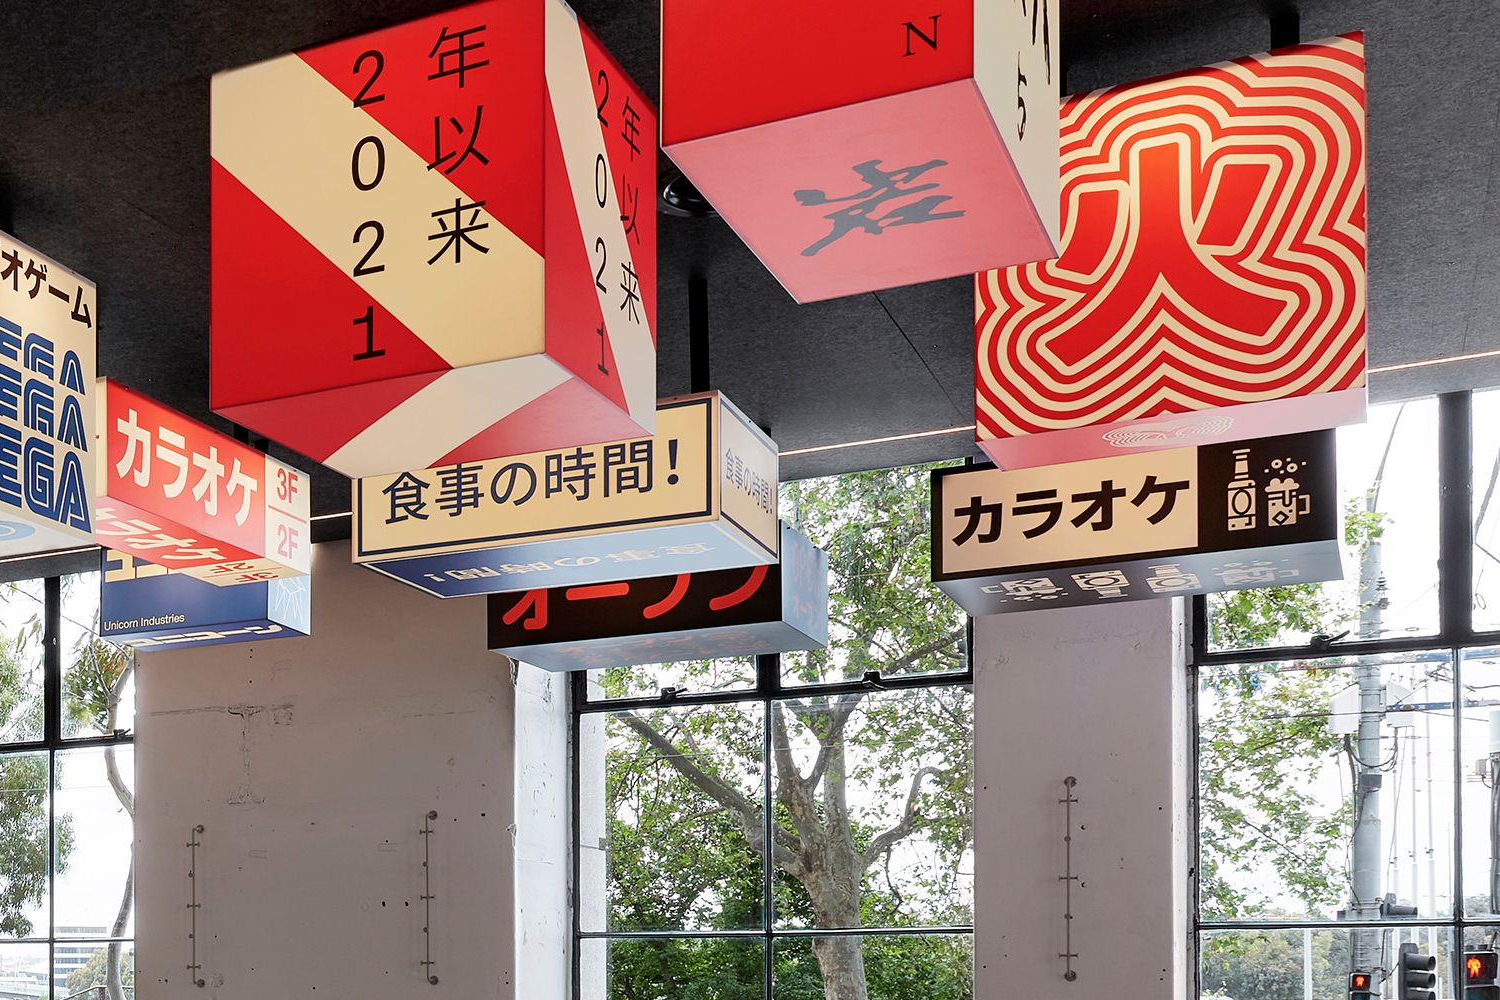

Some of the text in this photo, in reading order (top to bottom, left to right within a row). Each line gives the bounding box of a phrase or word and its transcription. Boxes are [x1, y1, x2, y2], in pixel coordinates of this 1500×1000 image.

[901, 13, 942, 58] N
[426, 25, 491, 266] 年以来
[351, 49, 387, 362] 2021
[595, 69, 609, 376] 2021
[620, 96, 642, 326] 年以来
[115, 408, 258, 527] カラオケ
[276, 467, 299, 504] 3F
[952, 475, 1192, 547] カラオケ
[276, 523, 300, 560] 2F
[104, 612, 186, 632] Unicorn Industries
